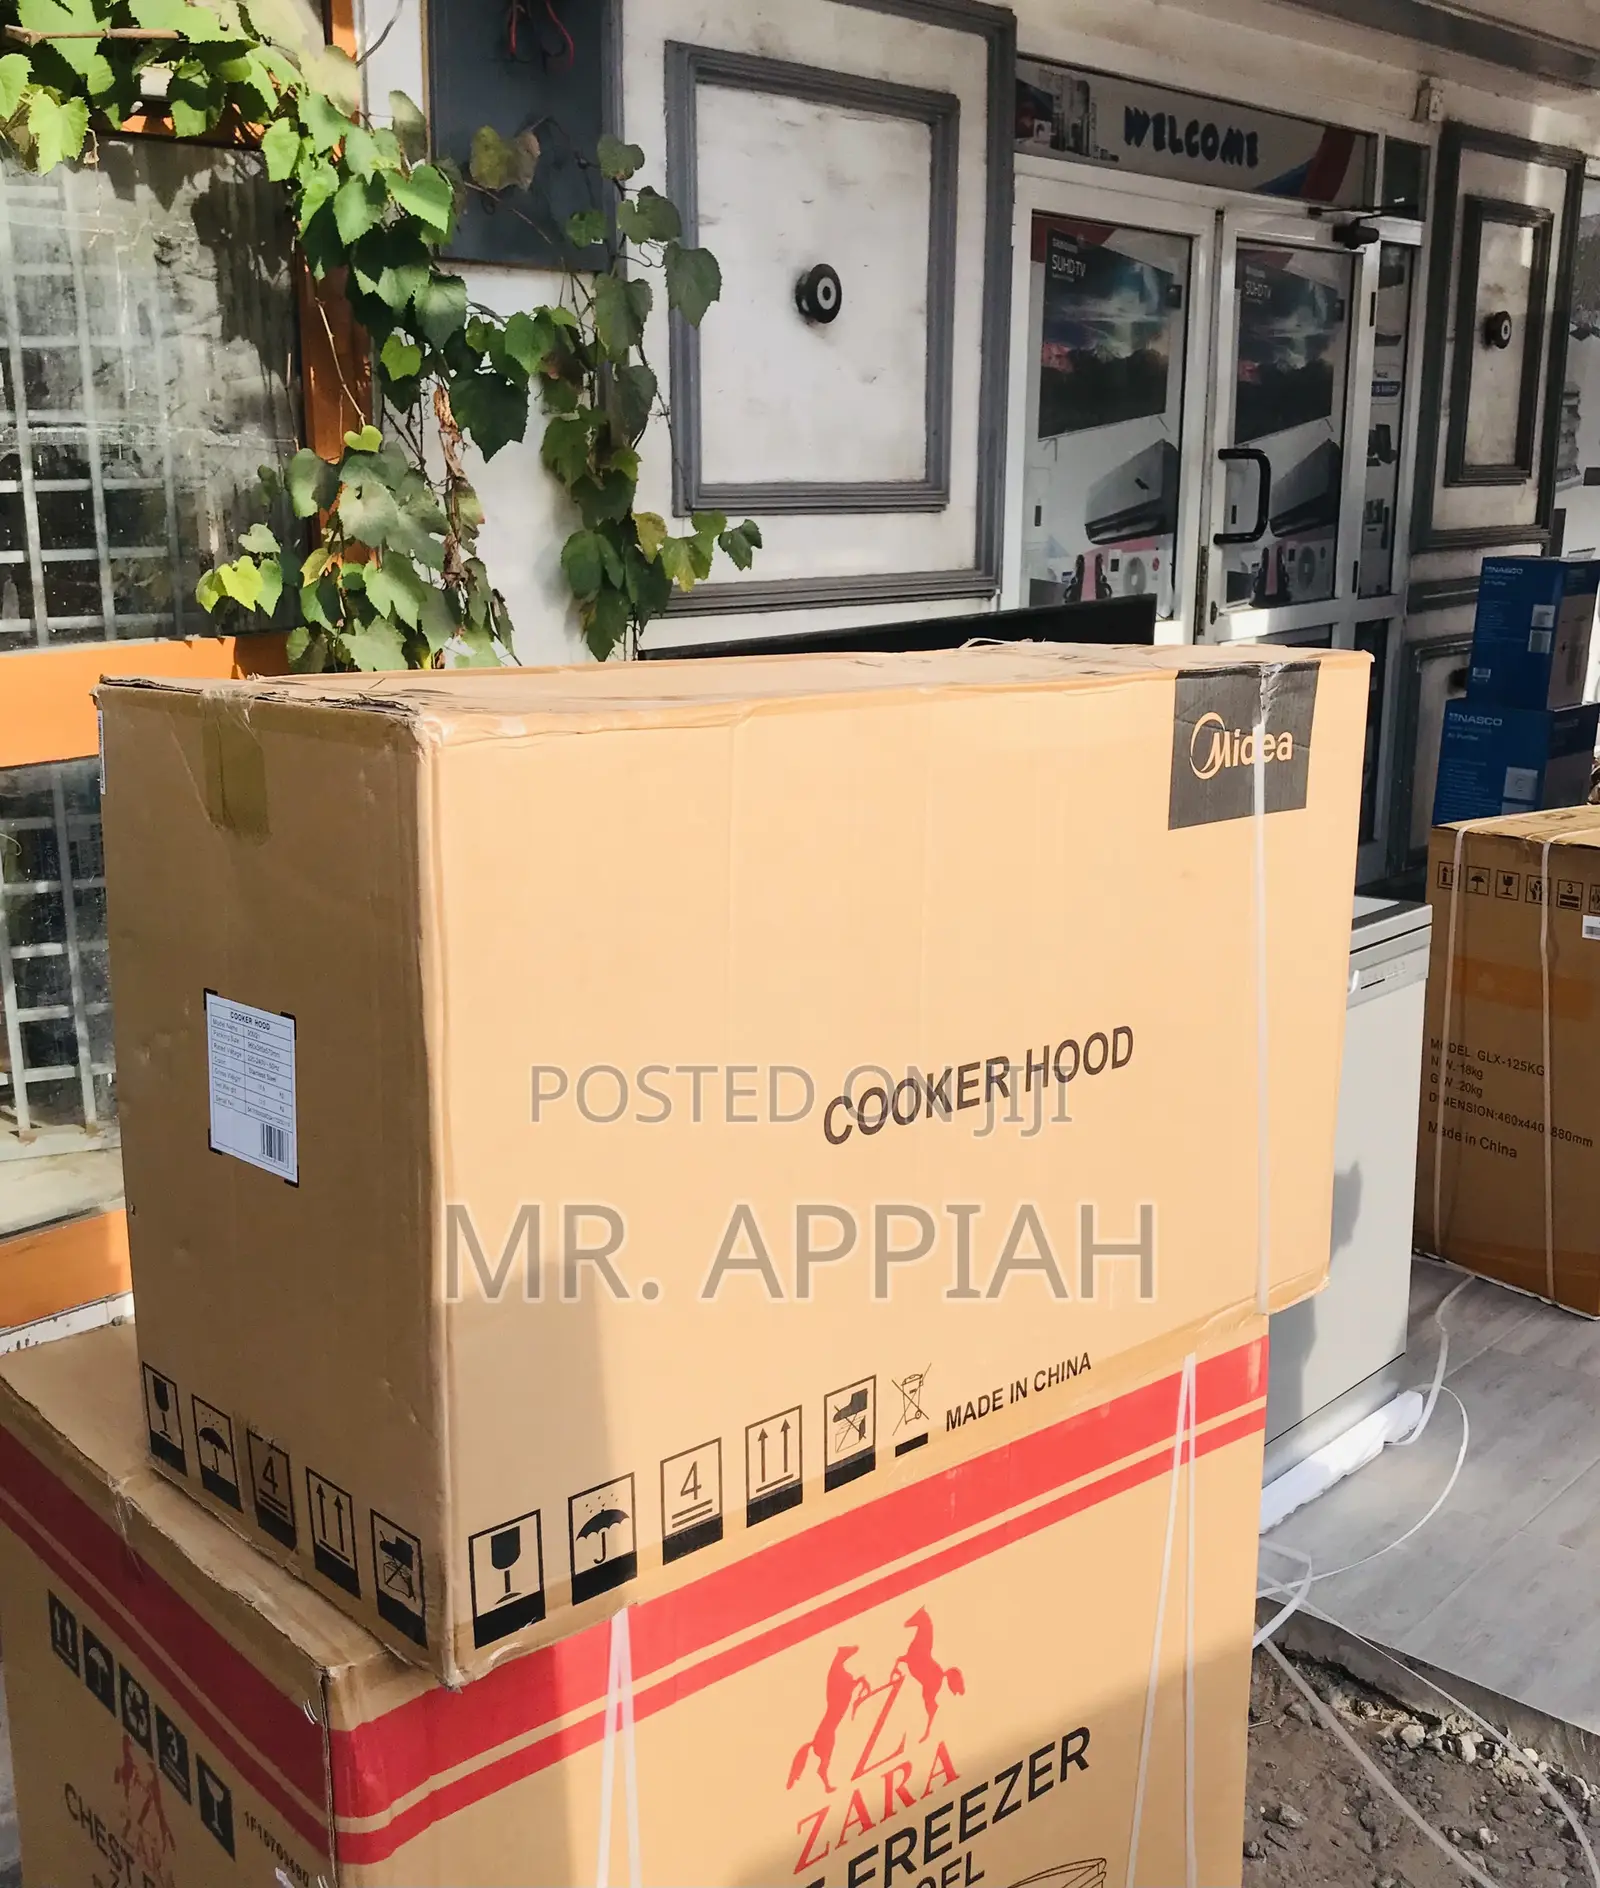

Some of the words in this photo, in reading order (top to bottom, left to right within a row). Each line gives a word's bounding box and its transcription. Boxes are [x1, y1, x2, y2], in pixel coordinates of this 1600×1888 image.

[1124, 105, 1259, 169] WELCOME
[1458, 714, 1503, 727] NASCO
[1190, 711, 1293, 780] Midea
[1567, 883, 1574, 894] 3
[230, 1011, 253, 1025] COOKER
[254, 1019, 271, 1031] HOOD
[1430, 1038, 1470, 1058] MDEL
[823, 1056, 1011, 1145] COOKER
[1025, 1026, 1134, 1093] HOOD
[1465, 1132, 1476, 1146] in
[1480, 1137, 1518, 1159] China
[946, 1387, 1004, 1432] MADE
[1010, 1376, 1028, 1405] IN
[1034, 1352, 1091, 1392] CHINA
[262, 1456, 278, 1495] 4
[681, 1460, 702, 1500] 4
[166, 1725, 179, 1764] 3
[793, 1740, 960, 1876] ZARA
[848, 1725, 1091, 1888] FREEZER
[64, 1782, 135, 1886] CHEST
